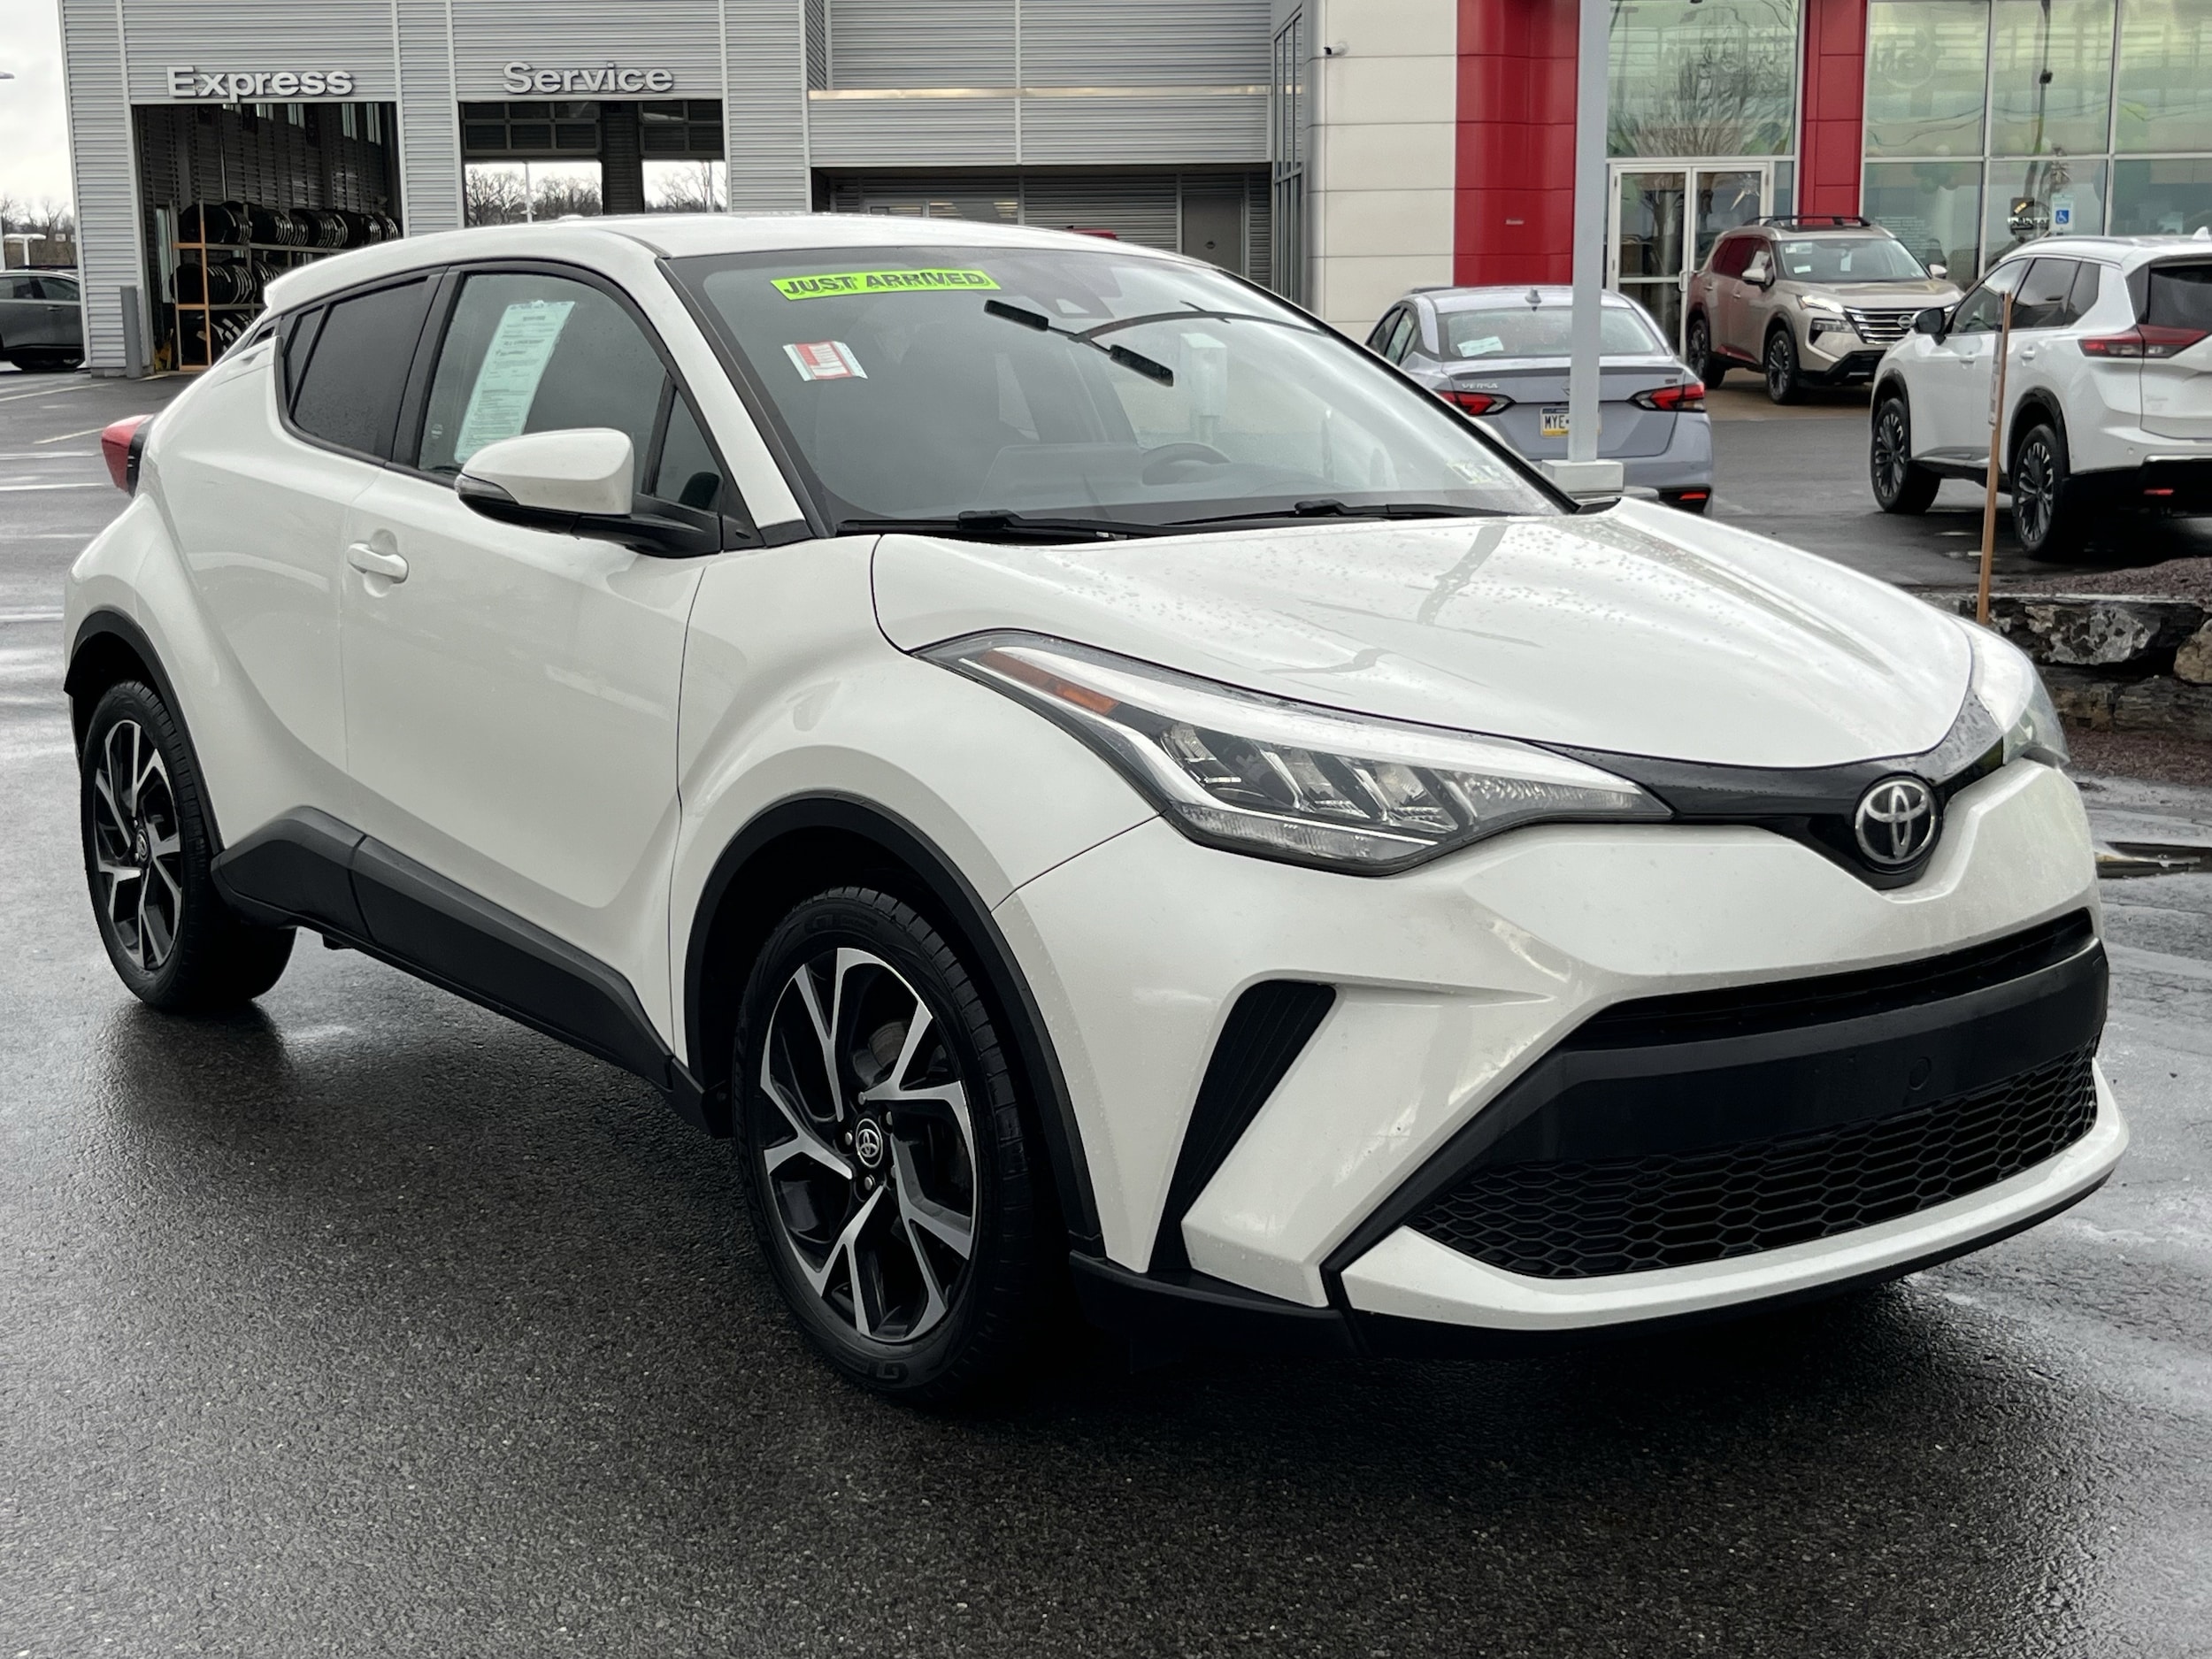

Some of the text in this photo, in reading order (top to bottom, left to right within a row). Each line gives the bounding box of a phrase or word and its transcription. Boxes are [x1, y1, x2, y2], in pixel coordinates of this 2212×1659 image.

[166, 61, 673, 104] Express Service
[784, 272, 988, 296] JUST ARRIVED
